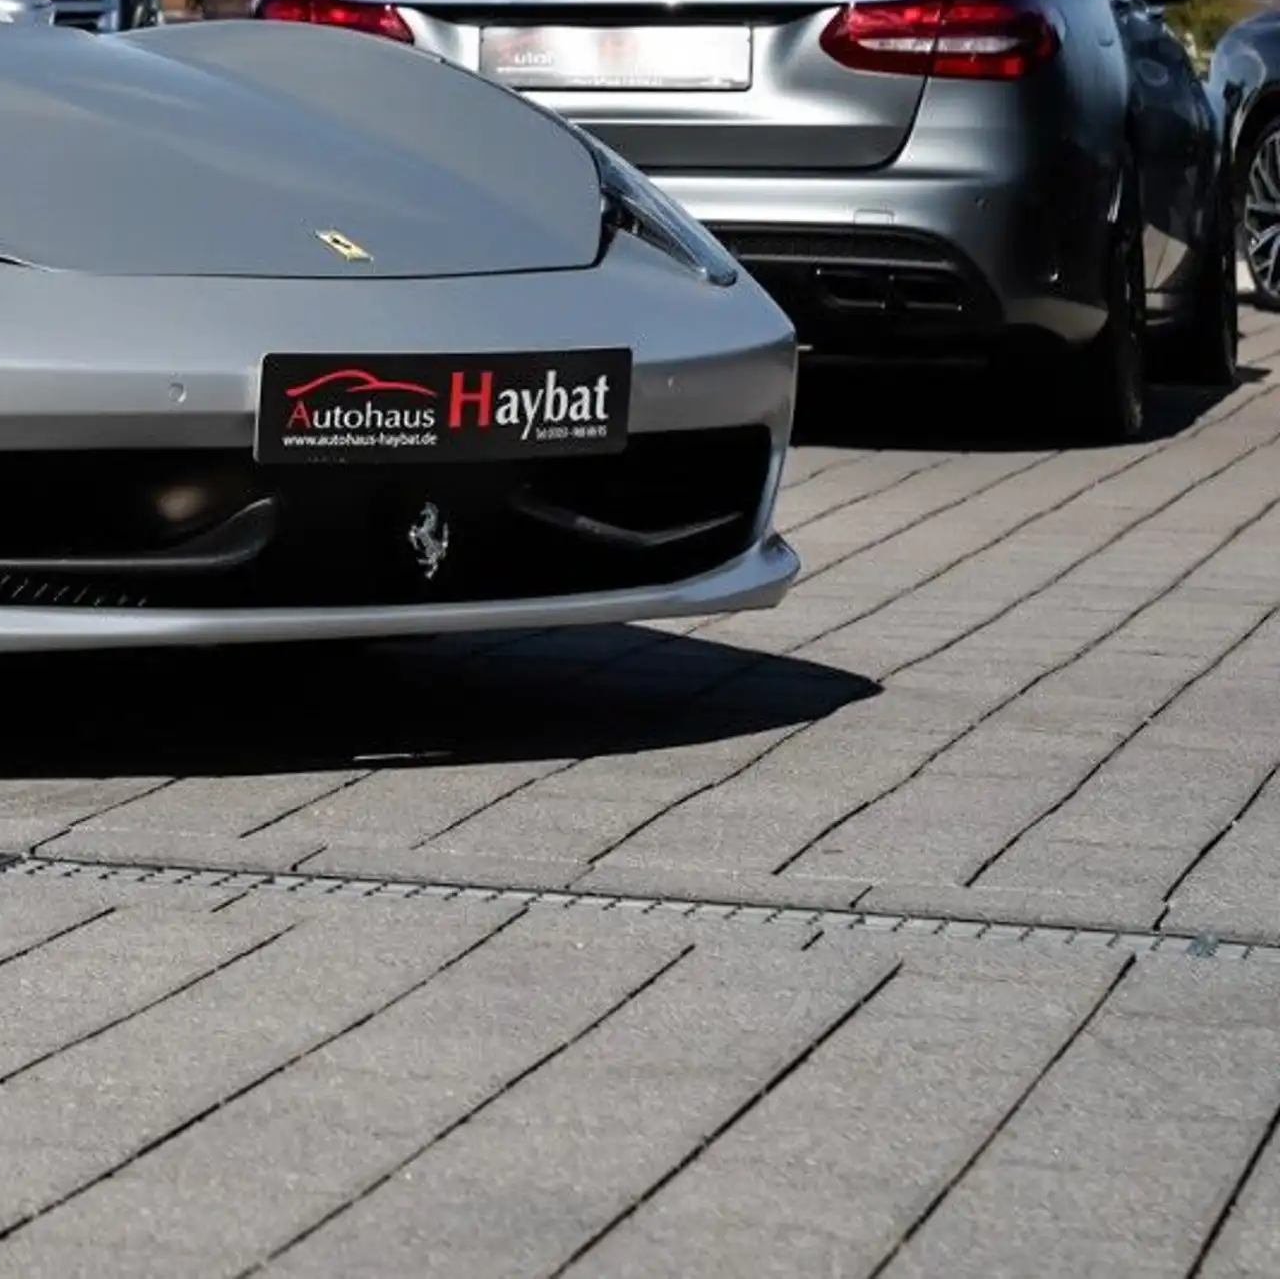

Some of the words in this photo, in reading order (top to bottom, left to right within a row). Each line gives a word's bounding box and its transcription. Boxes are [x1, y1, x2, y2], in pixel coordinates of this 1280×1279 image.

[286, 401, 436, 430] Autohaus
[449, 369, 610, 440] Haybat
[282, 431, 438, 447] www.autohaus-haybat.de
